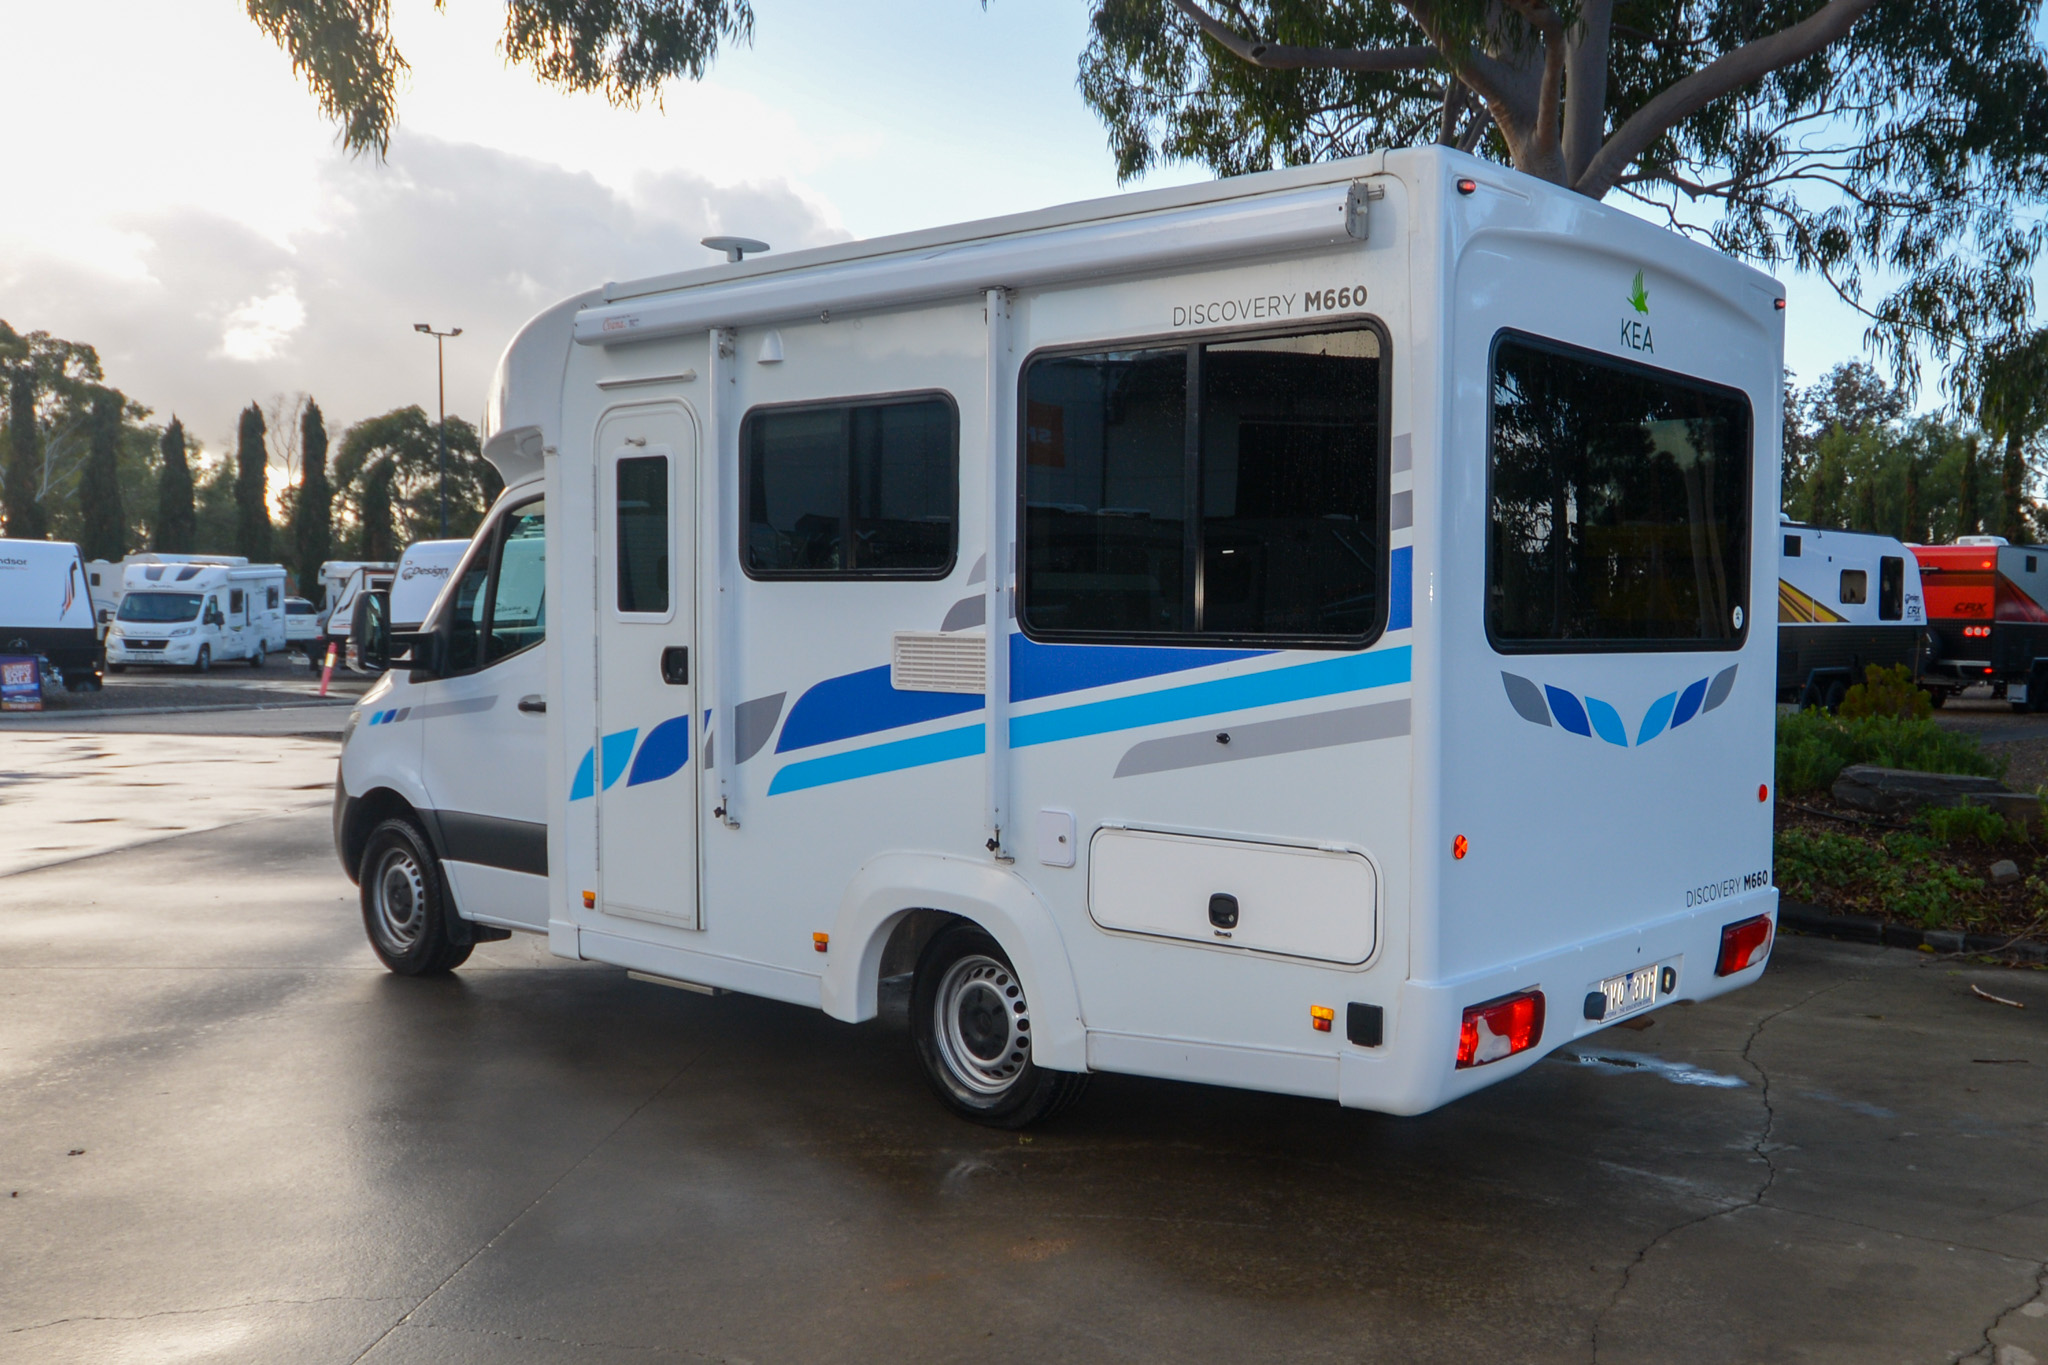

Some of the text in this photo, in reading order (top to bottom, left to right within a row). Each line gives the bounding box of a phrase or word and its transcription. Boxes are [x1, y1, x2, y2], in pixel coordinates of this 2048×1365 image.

[1173, 285, 1368, 327] DISCOVERY M660
[1620, 317, 1654, 354] KEA
[1686, 869, 1769, 908] DISCOVERY M660
